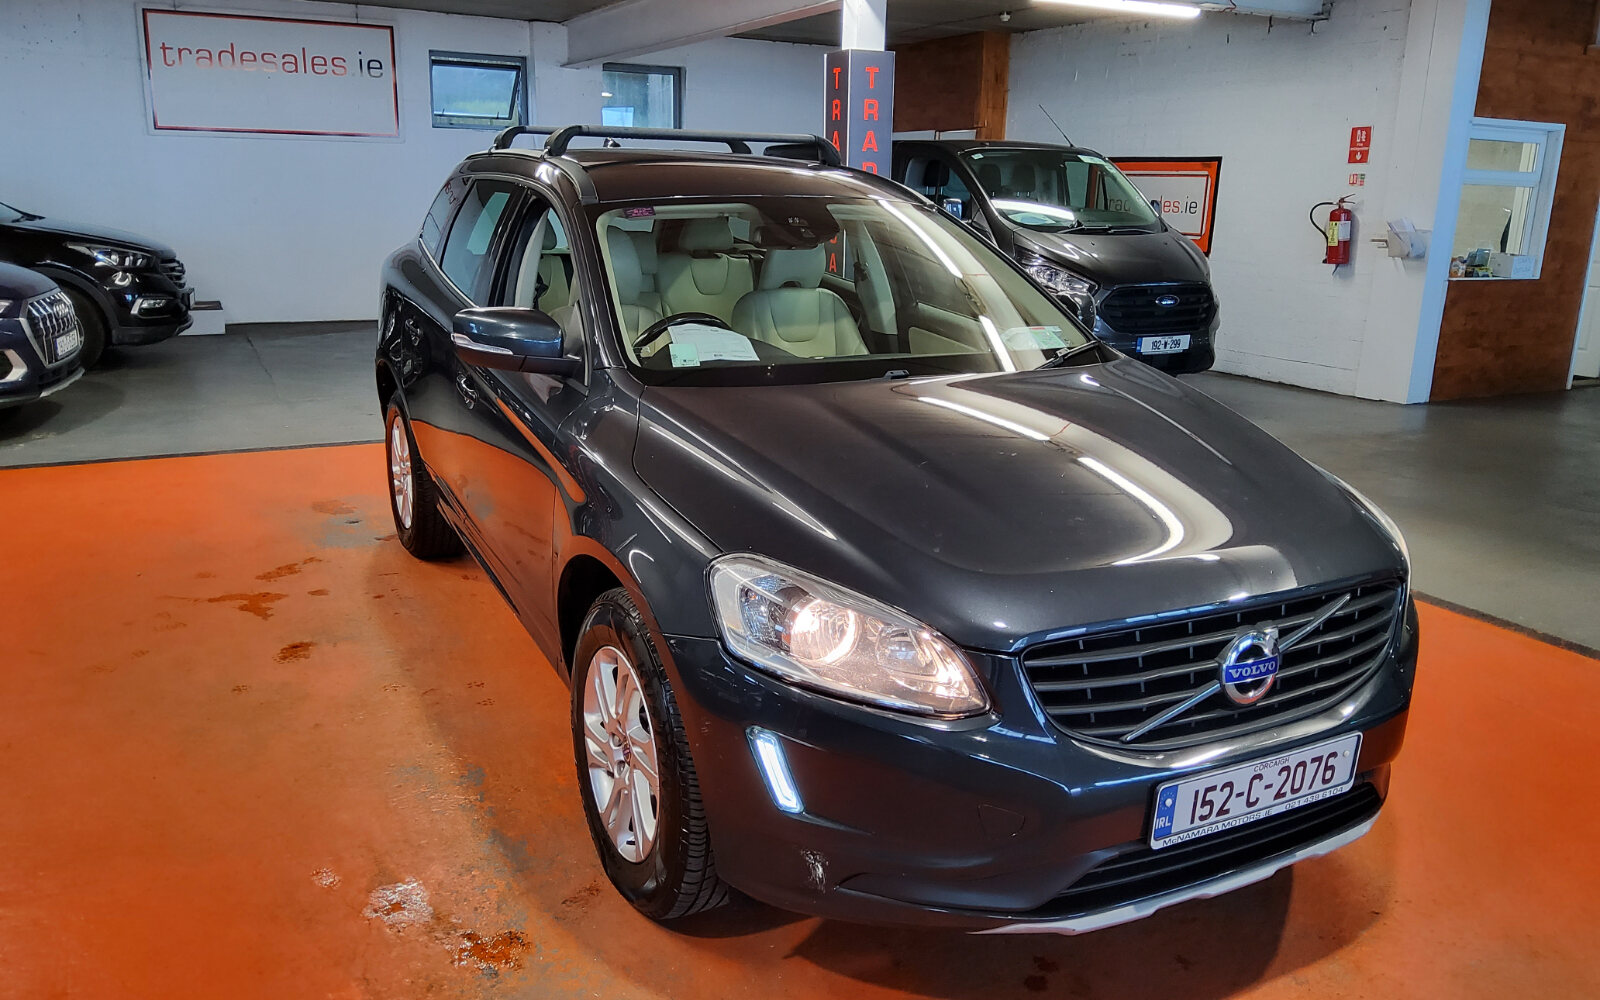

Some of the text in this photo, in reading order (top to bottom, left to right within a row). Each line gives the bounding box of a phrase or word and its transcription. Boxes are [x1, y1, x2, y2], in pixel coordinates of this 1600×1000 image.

[160, 42, 384, 79] tradesales.ie
[1229, 661, 1276, 678] VOLVO
[1253, 757, 1290, 772] CORCAIGH
[1189, 751, 1339, 825] 152-C-2076
[1155, 816, 1172, 830] IRL
